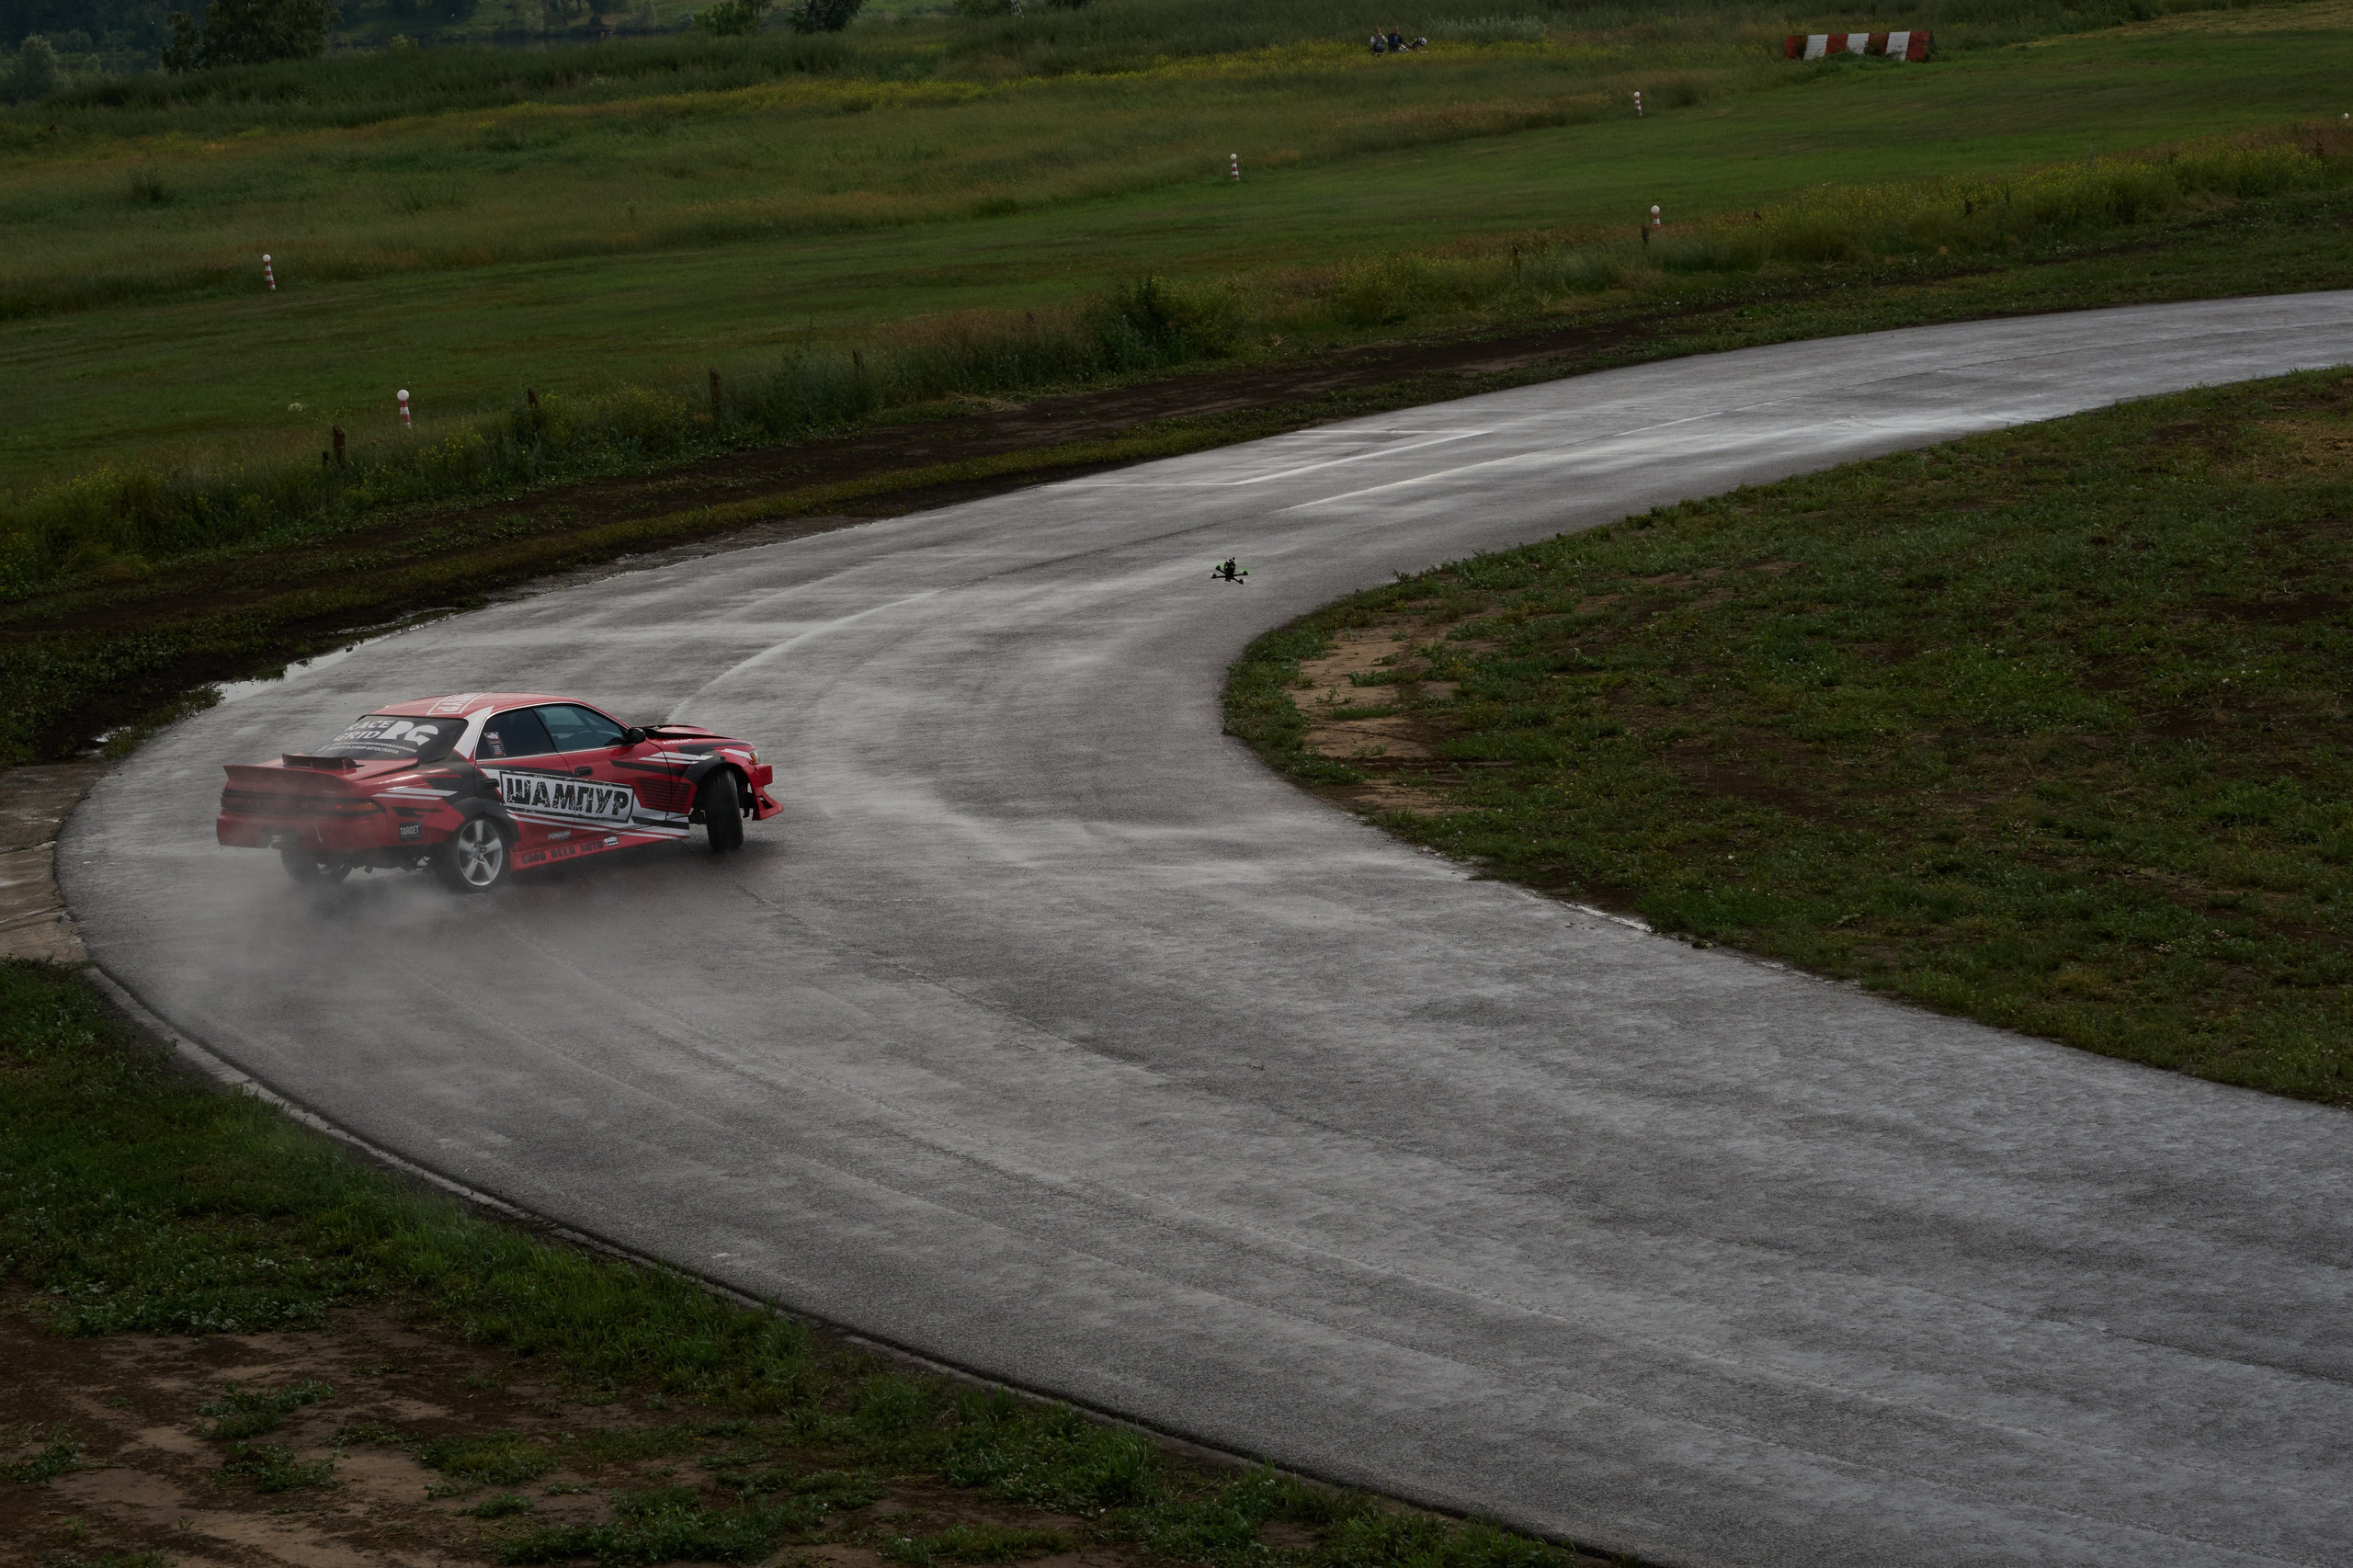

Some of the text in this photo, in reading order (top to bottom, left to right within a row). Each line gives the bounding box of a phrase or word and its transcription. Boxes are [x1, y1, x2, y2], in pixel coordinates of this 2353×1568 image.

[343, 721, 395, 733] RACE
[333, 731, 381, 742] GRID
[506, 778, 629, 815] ШАМПУР
[399, 825, 420, 835] TARGET
